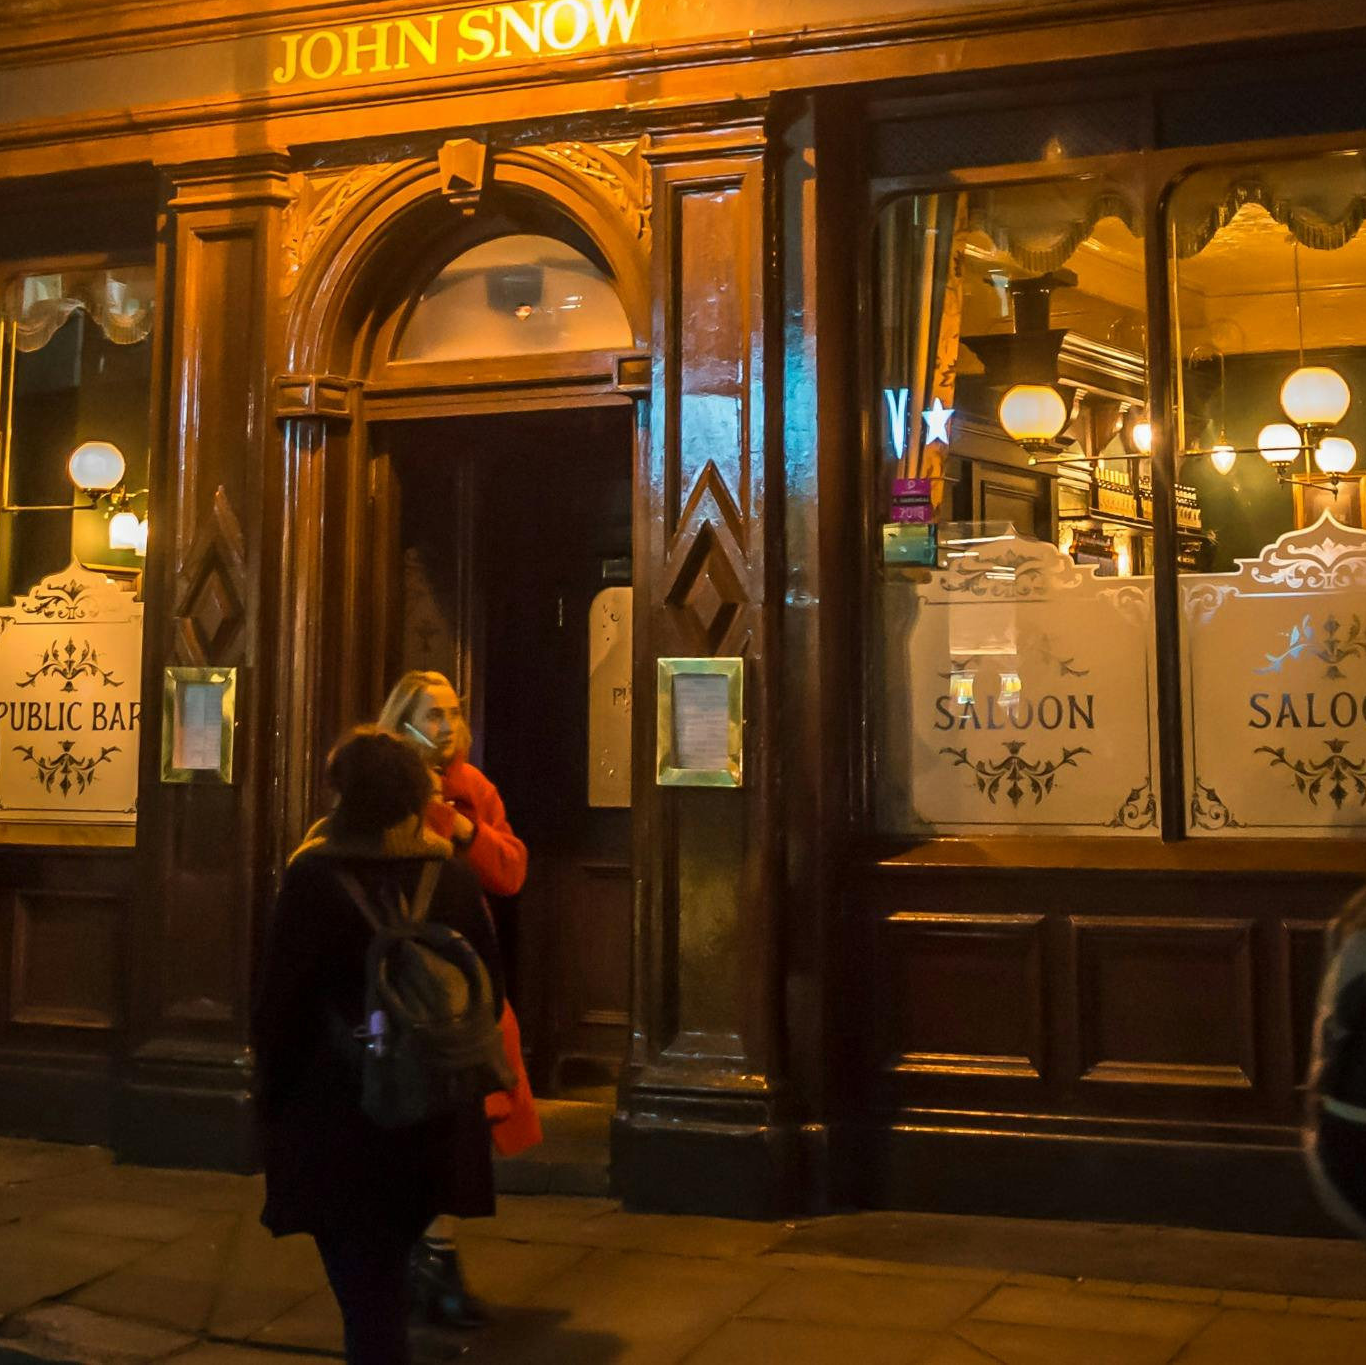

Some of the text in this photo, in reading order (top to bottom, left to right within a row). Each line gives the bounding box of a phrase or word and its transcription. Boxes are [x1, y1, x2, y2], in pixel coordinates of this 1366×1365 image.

[273, 15, 444, 84] JOHN
[92, 701, 142, 731] BAR
[934, 694, 1095, 730] SALOON
